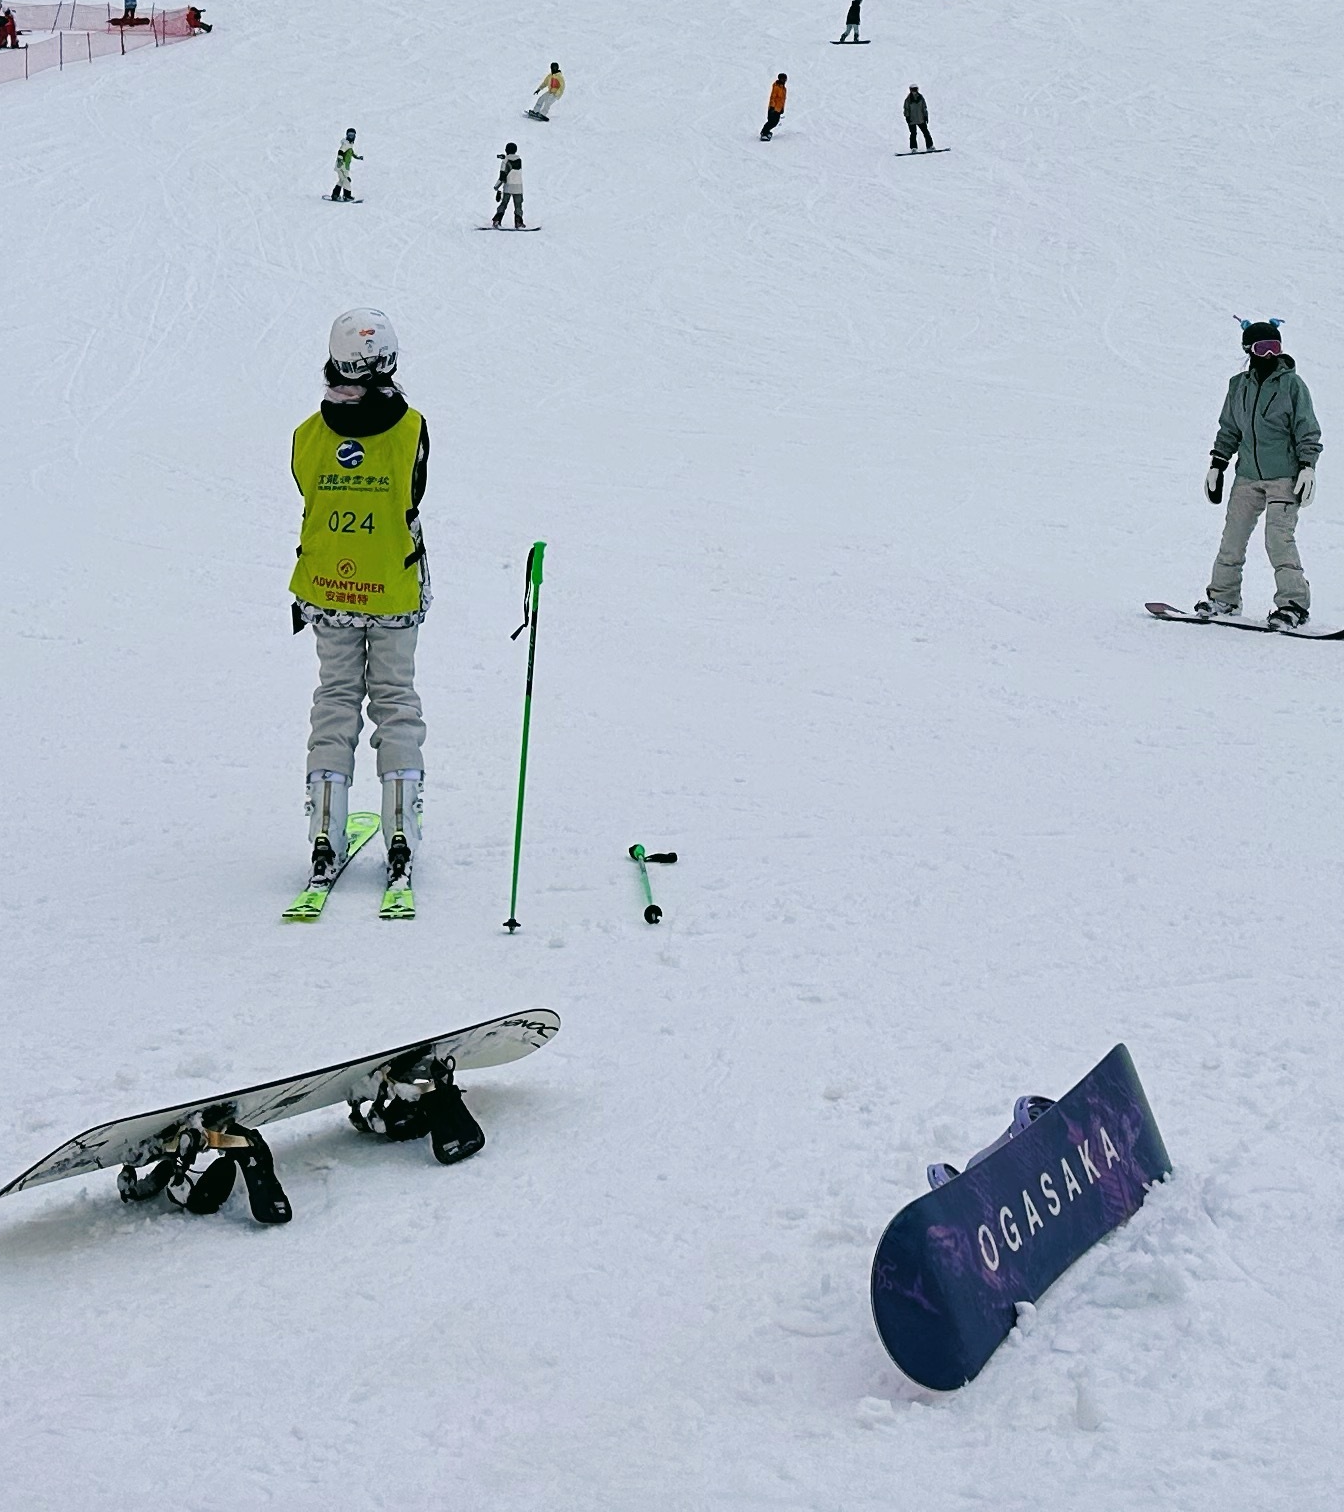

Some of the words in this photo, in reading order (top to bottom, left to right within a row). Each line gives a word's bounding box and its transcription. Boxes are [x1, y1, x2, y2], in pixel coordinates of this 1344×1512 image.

[328, 510, 375, 534] 024
[312, 575, 385, 594] ADVANTURER
[977, 1126, 1121, 1272] OGASAKA
